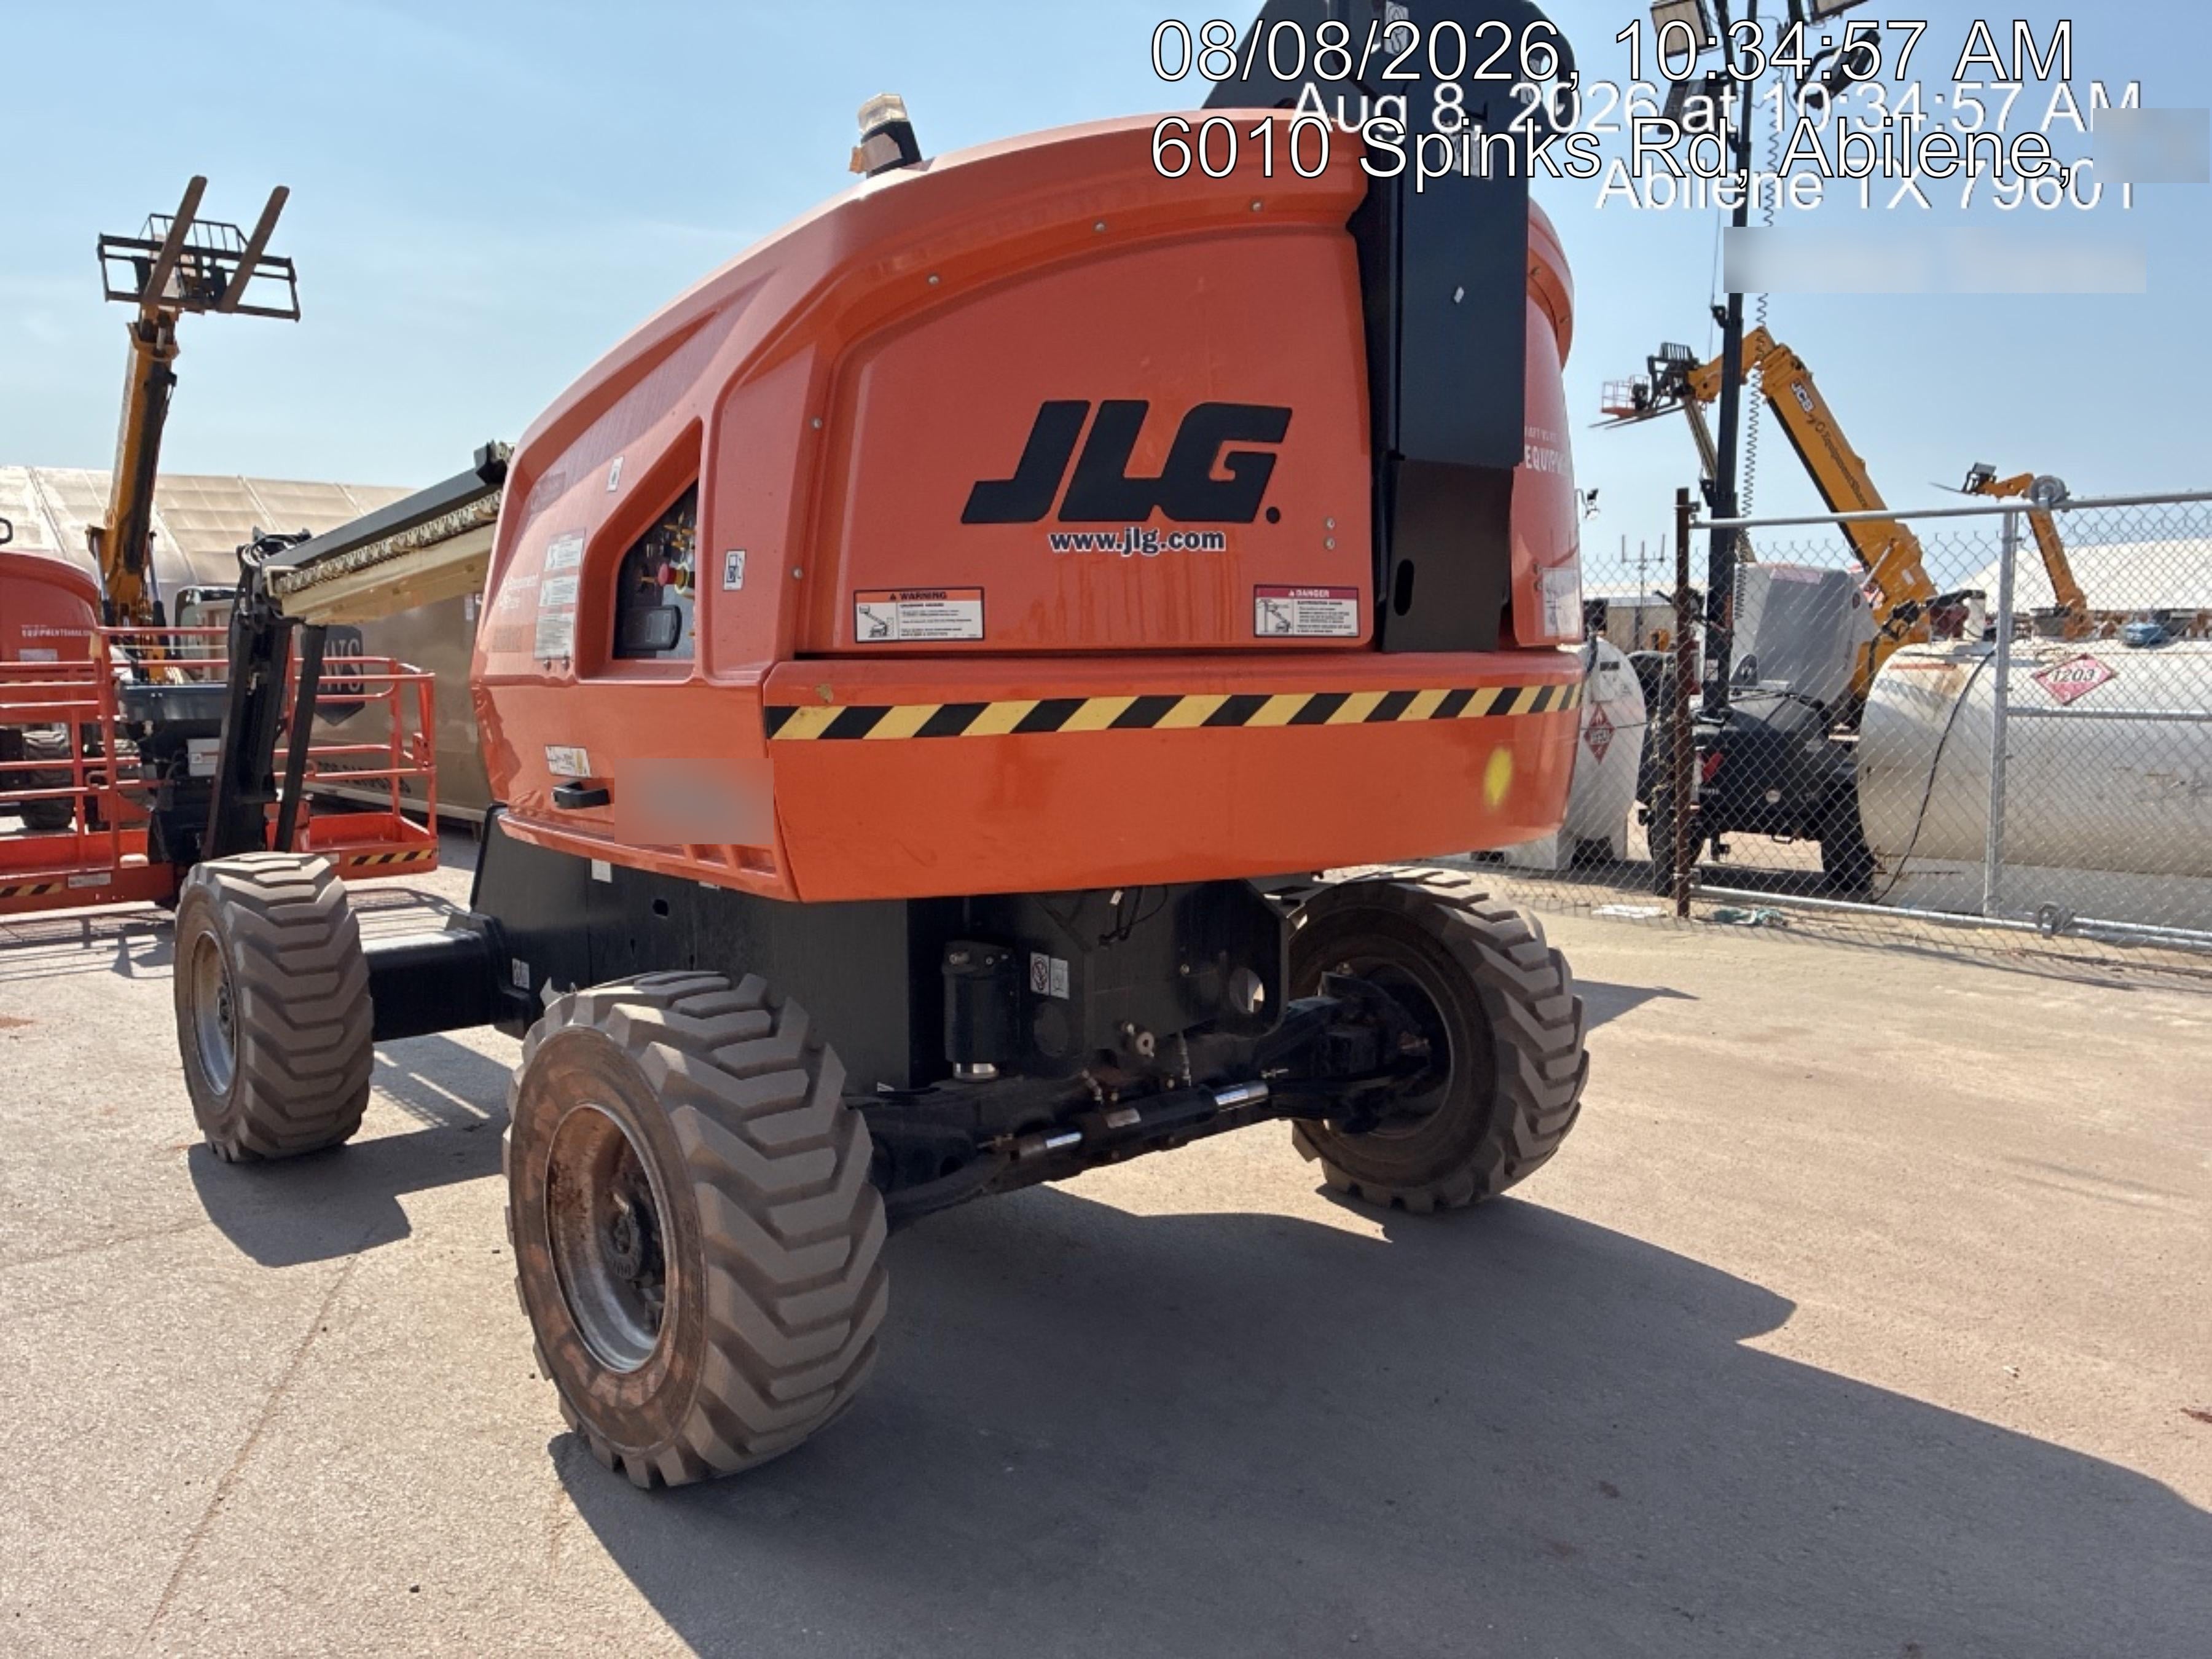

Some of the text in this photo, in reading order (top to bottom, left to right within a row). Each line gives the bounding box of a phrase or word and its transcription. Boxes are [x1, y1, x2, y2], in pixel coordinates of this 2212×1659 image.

[1790, 380, 1815, 413] JCB
[1048, 526, 1226, 557] www.jlg.com
[899, 591, 947, 600] WARNING
[1296, 589, 1330, 598] DANGER
[2053, 668, 2095, 681] 1203
